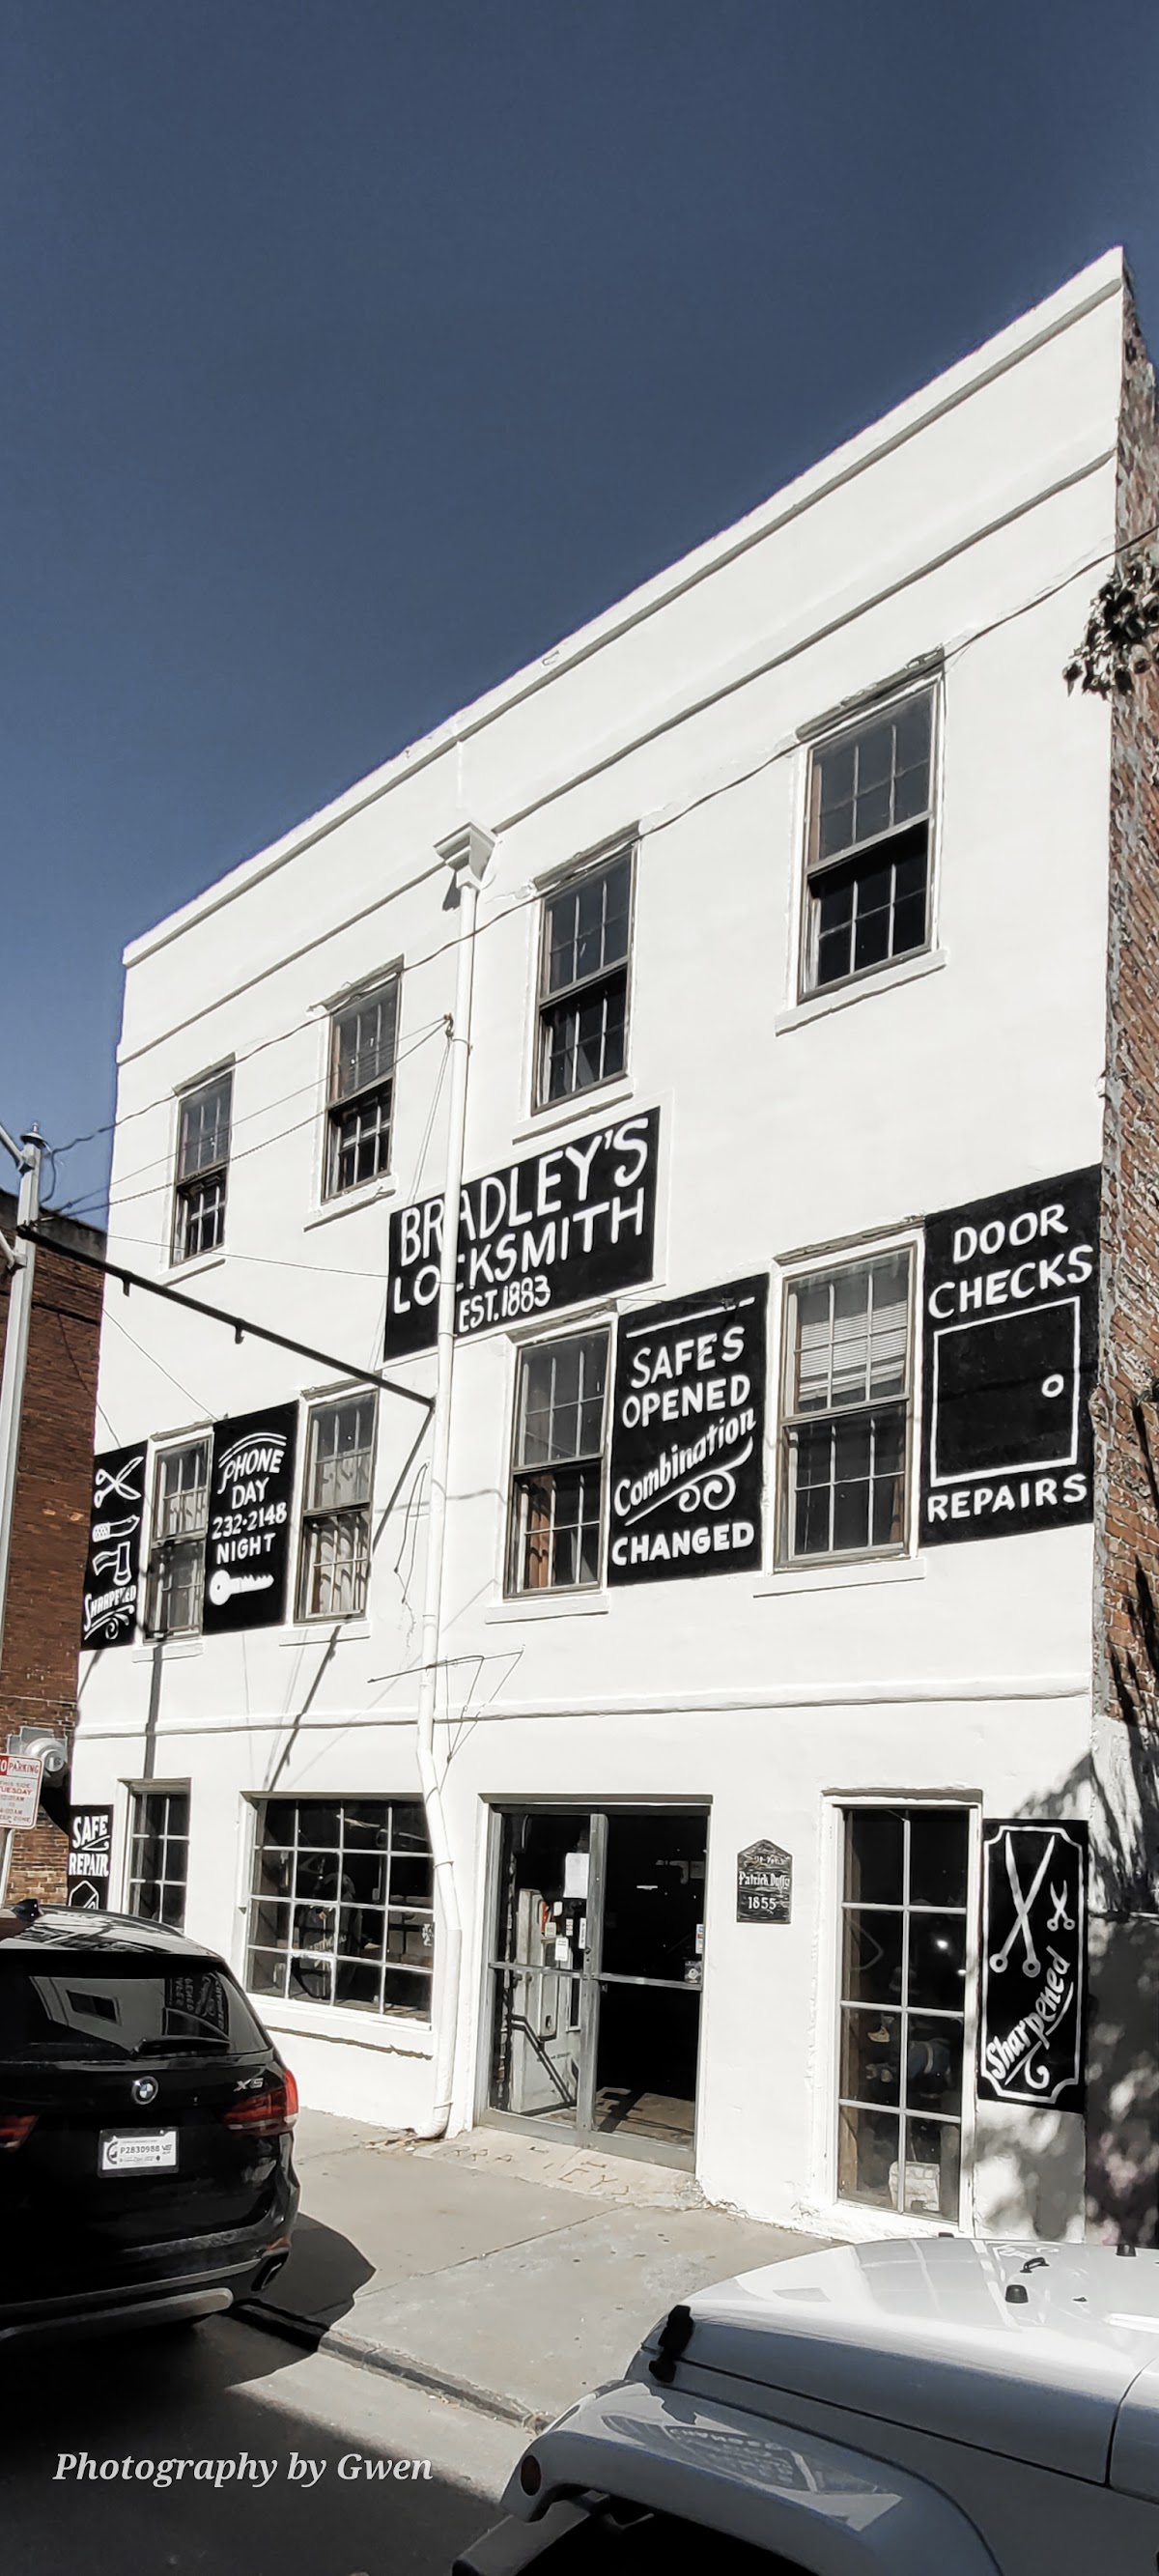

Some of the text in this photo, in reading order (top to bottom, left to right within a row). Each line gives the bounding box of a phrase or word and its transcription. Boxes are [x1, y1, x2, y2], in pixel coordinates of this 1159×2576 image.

[401, 1118, 648, 1266] BRADLEY'S
[953, 1203, 1068, 1264] DOOR
[928, 1244, 1093, 1318] CHECKS
[630, 1326, 745, 1389] SAFES
[622, 1374, 750, 1429] OPENED
[217, 1448, 284, 1494] PHONE
[614, 1407, 756, 1516] Combination
[232, 1477, 269, 1509] DAY
[927, 1473, 1088, 1523] REPAIRS
[216, 1533, 276, 1565] NIGHT
[611, 1521, 754, 1566] CHANGED
[9, 1762, 39, 1773] PARKING
[0, 1786, 32, 1796] UESDAY
[72, 1815, 108, 1849] SAFE
[69, 1853, 109, 1877] REPAIR
[748, 1896, 777, 1910] 1855
[986, 1945, 1070, 2080] Sharpened
[233, 2078, 264, 2092] X5
